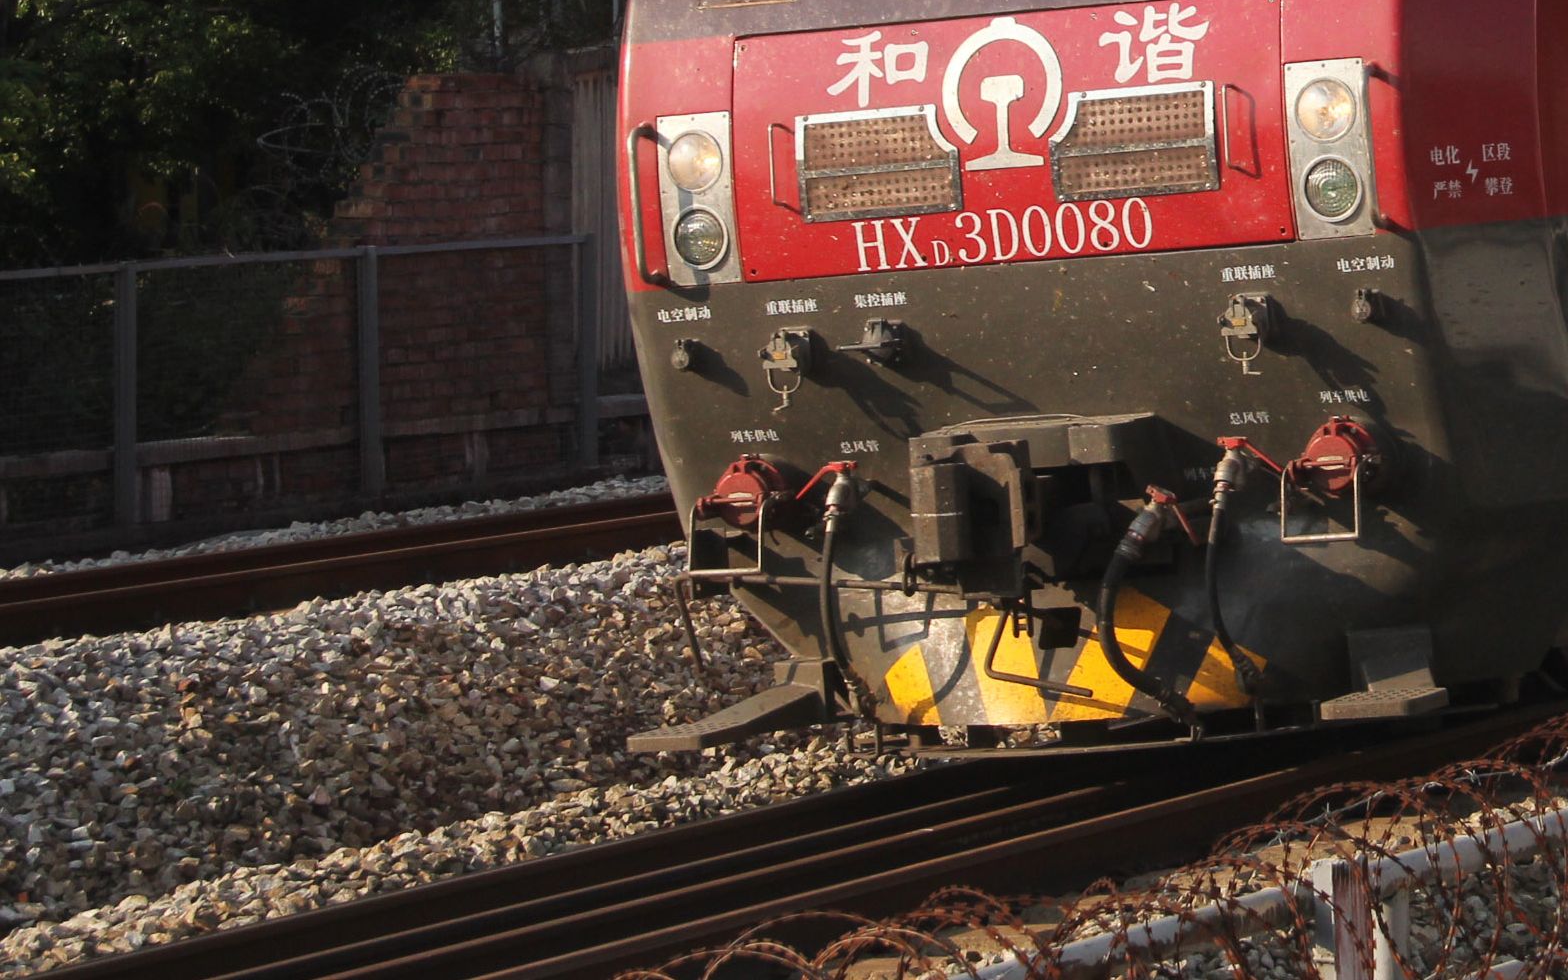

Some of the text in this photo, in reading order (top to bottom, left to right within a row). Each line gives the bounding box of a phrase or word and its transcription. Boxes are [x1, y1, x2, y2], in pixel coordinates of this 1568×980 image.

[826, 2, 1210, 108] 和 谐
[1336, 254, 1395, 273] 电空制动
[1221, 264, 1276, 282] 重联插座
[765, 297, 819, 316] 重联插座
[854, 291, 907, 309] 集控插座
[657, 305, 712, 323] 电空制动
[1319, 388, 1370, 404] 列车供电
[1229, 411, 1271, 425] 总风管
[730, 428, 780, 443] 列车供电
[840, 439, 880, 454] 总风管
